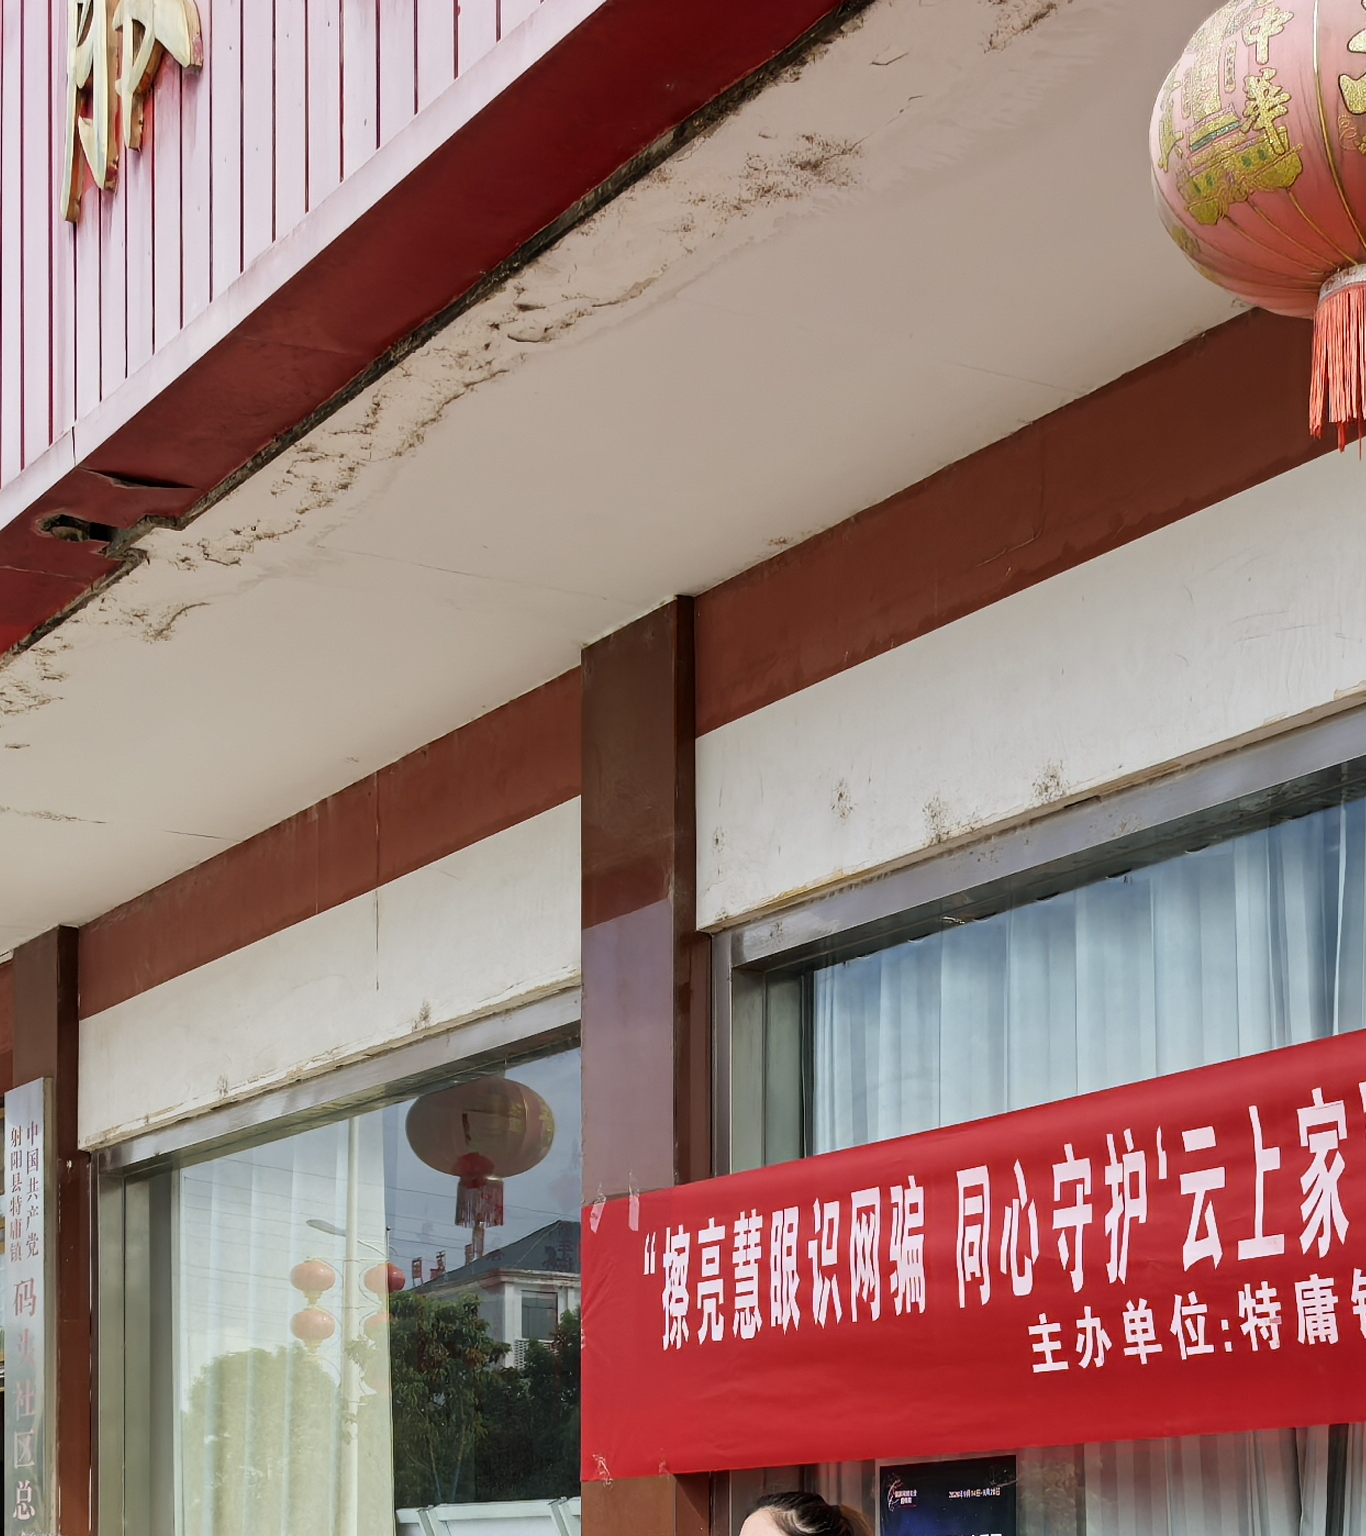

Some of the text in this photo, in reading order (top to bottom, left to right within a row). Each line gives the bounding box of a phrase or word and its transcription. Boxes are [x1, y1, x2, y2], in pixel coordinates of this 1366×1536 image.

[10, 1126, 24, 1262] 射阳县特庸镇
[25, 1120, 40, 1258] 中国共产党
[644, 1175, 926, 1350] “擦亮慧眼识网骗
[12, 1279, 39, 1536] 码头社区总
